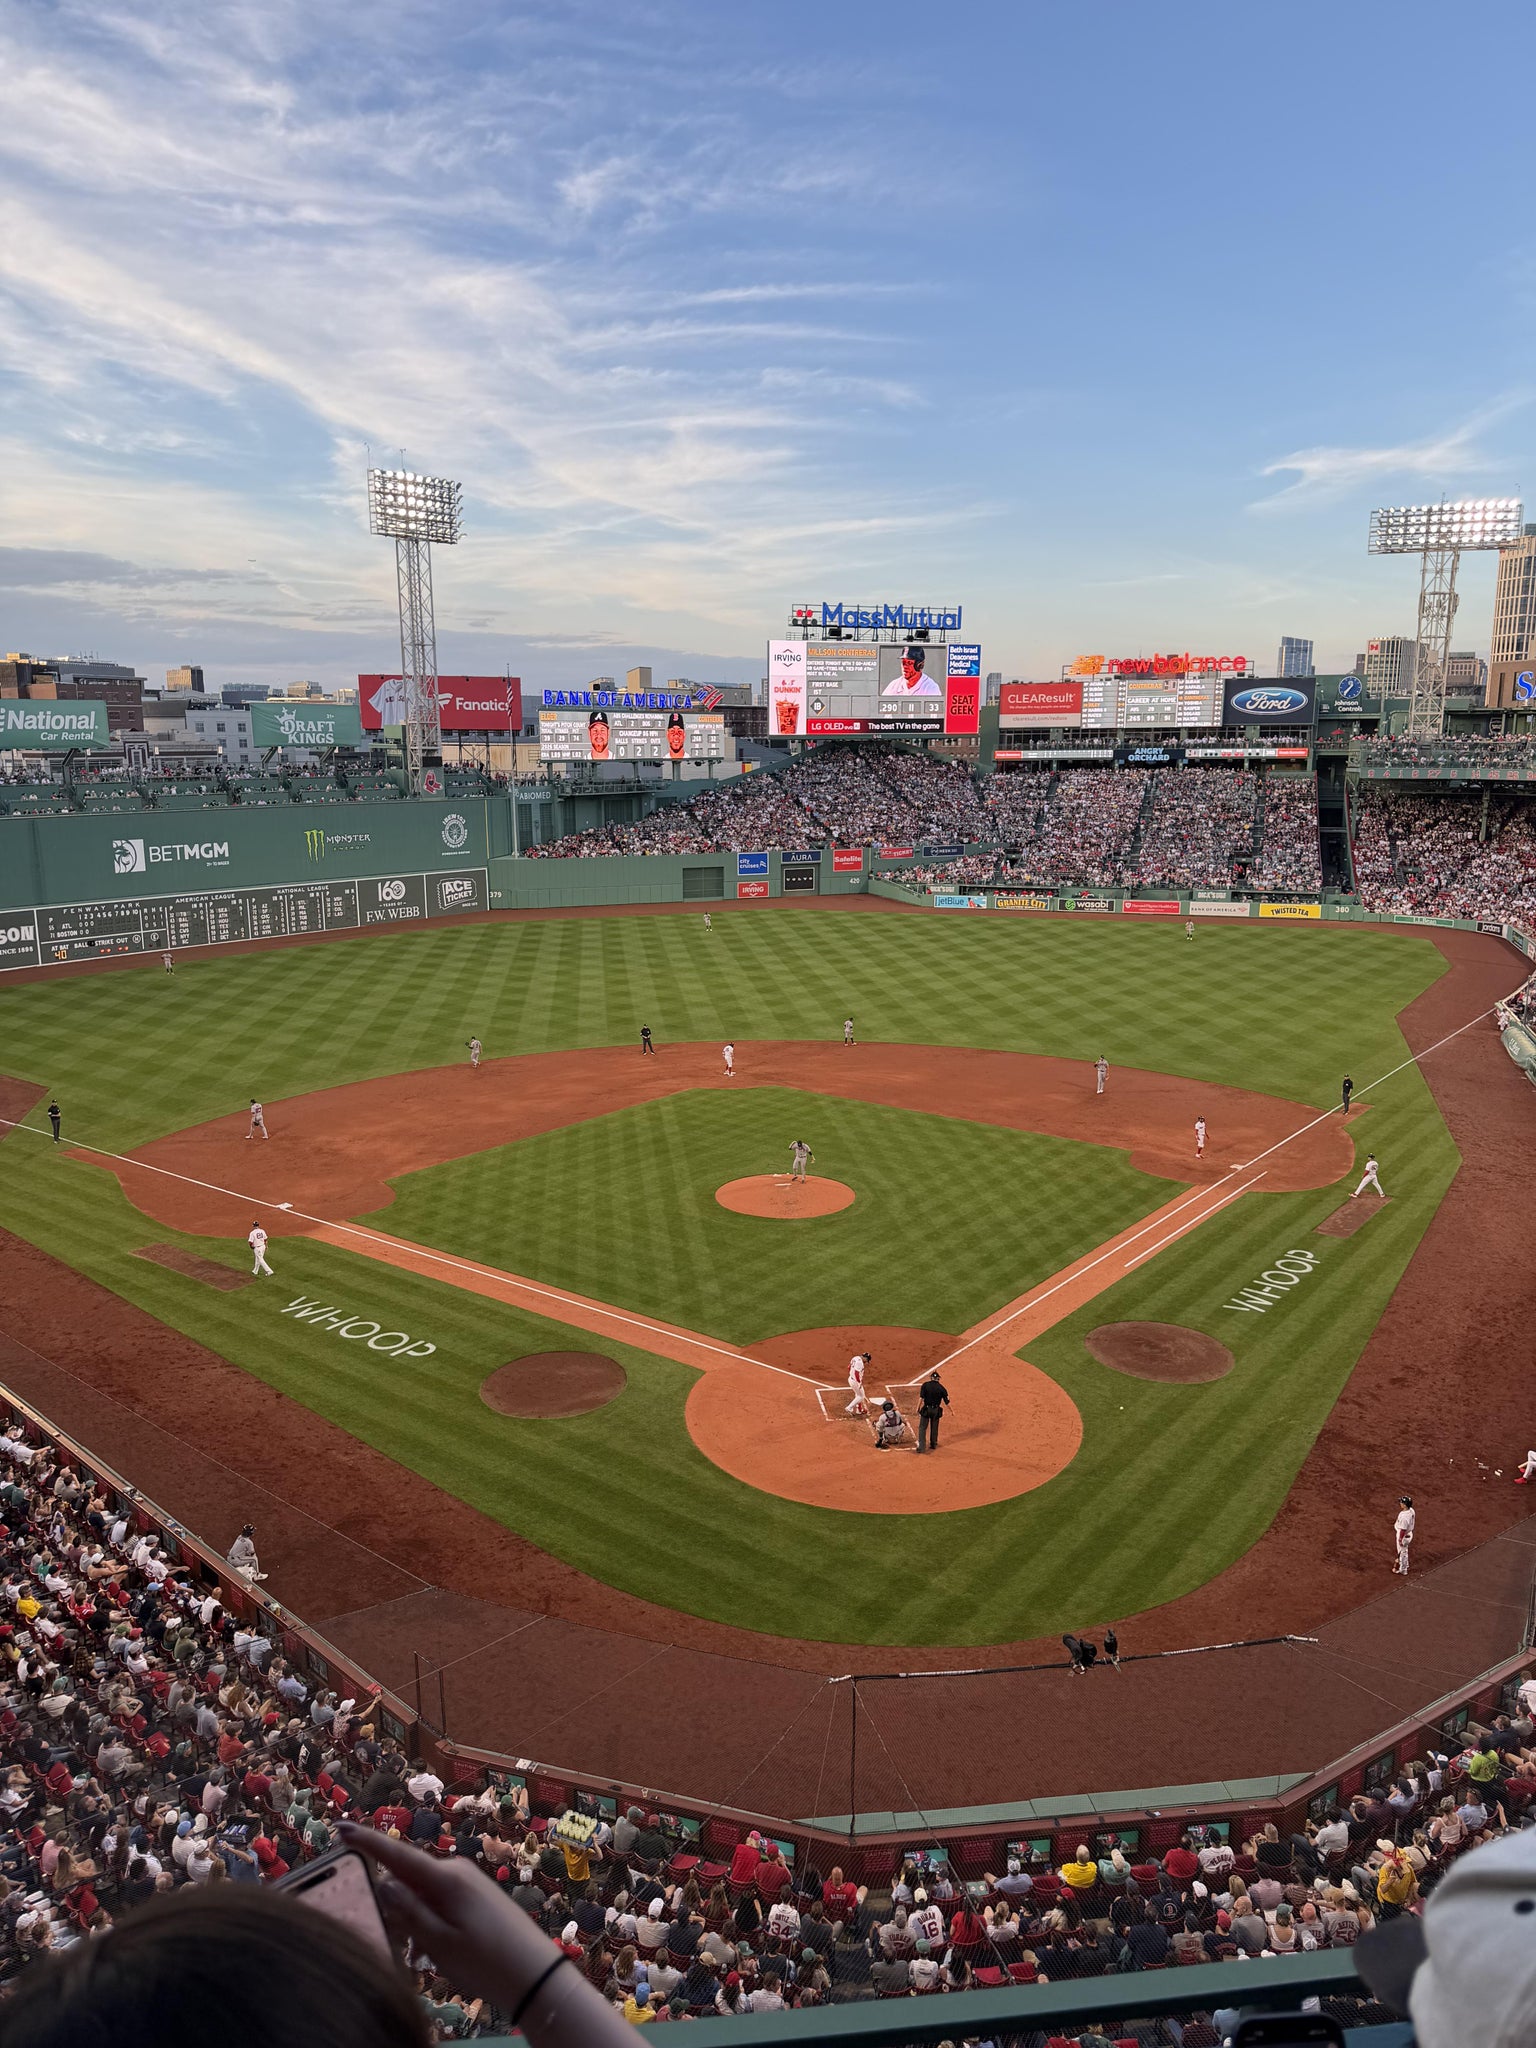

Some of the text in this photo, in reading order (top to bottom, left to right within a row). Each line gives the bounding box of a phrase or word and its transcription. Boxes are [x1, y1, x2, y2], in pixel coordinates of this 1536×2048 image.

[822, 601, 962, 630] MassMutual
[1108, 652, 1247, 674] new balance
[455, 697, 511, 711] Fanatics
[543, 689, 693, 709] BANK OF AMERICA
[952, 695, 974, 705] SEAT
[1246, 691, 1292, 710] Ford
[928, 704, 939, 712] 33
[950, 705, 974, 715] GEEK
[280, 718, 335, 734] DRAFT
[40, 731, 94, 740] Car Rental
[288, 732, 335, 744] KINGS
[620, 746, 659, 757] 0 2 2
[148, 841, 230, 863] BETMGM
[444, 880, 472, 896] ACE
[742, 886, 764, 894] IRVING
[446, 890, 473, 904] TICKET
[937, 898, 964, 906] jetBlue
[1076, 900, 1110, 908] wasabi
[63, 906, 106, 914] FENWAY
[388, 906, 420, 920] WEBB
[1270, 908, 1297, 916] TWISTED
[1222, 1249, 1321, 1313] WHOOP
[280, 1296, 437, 1357] WHOOP
